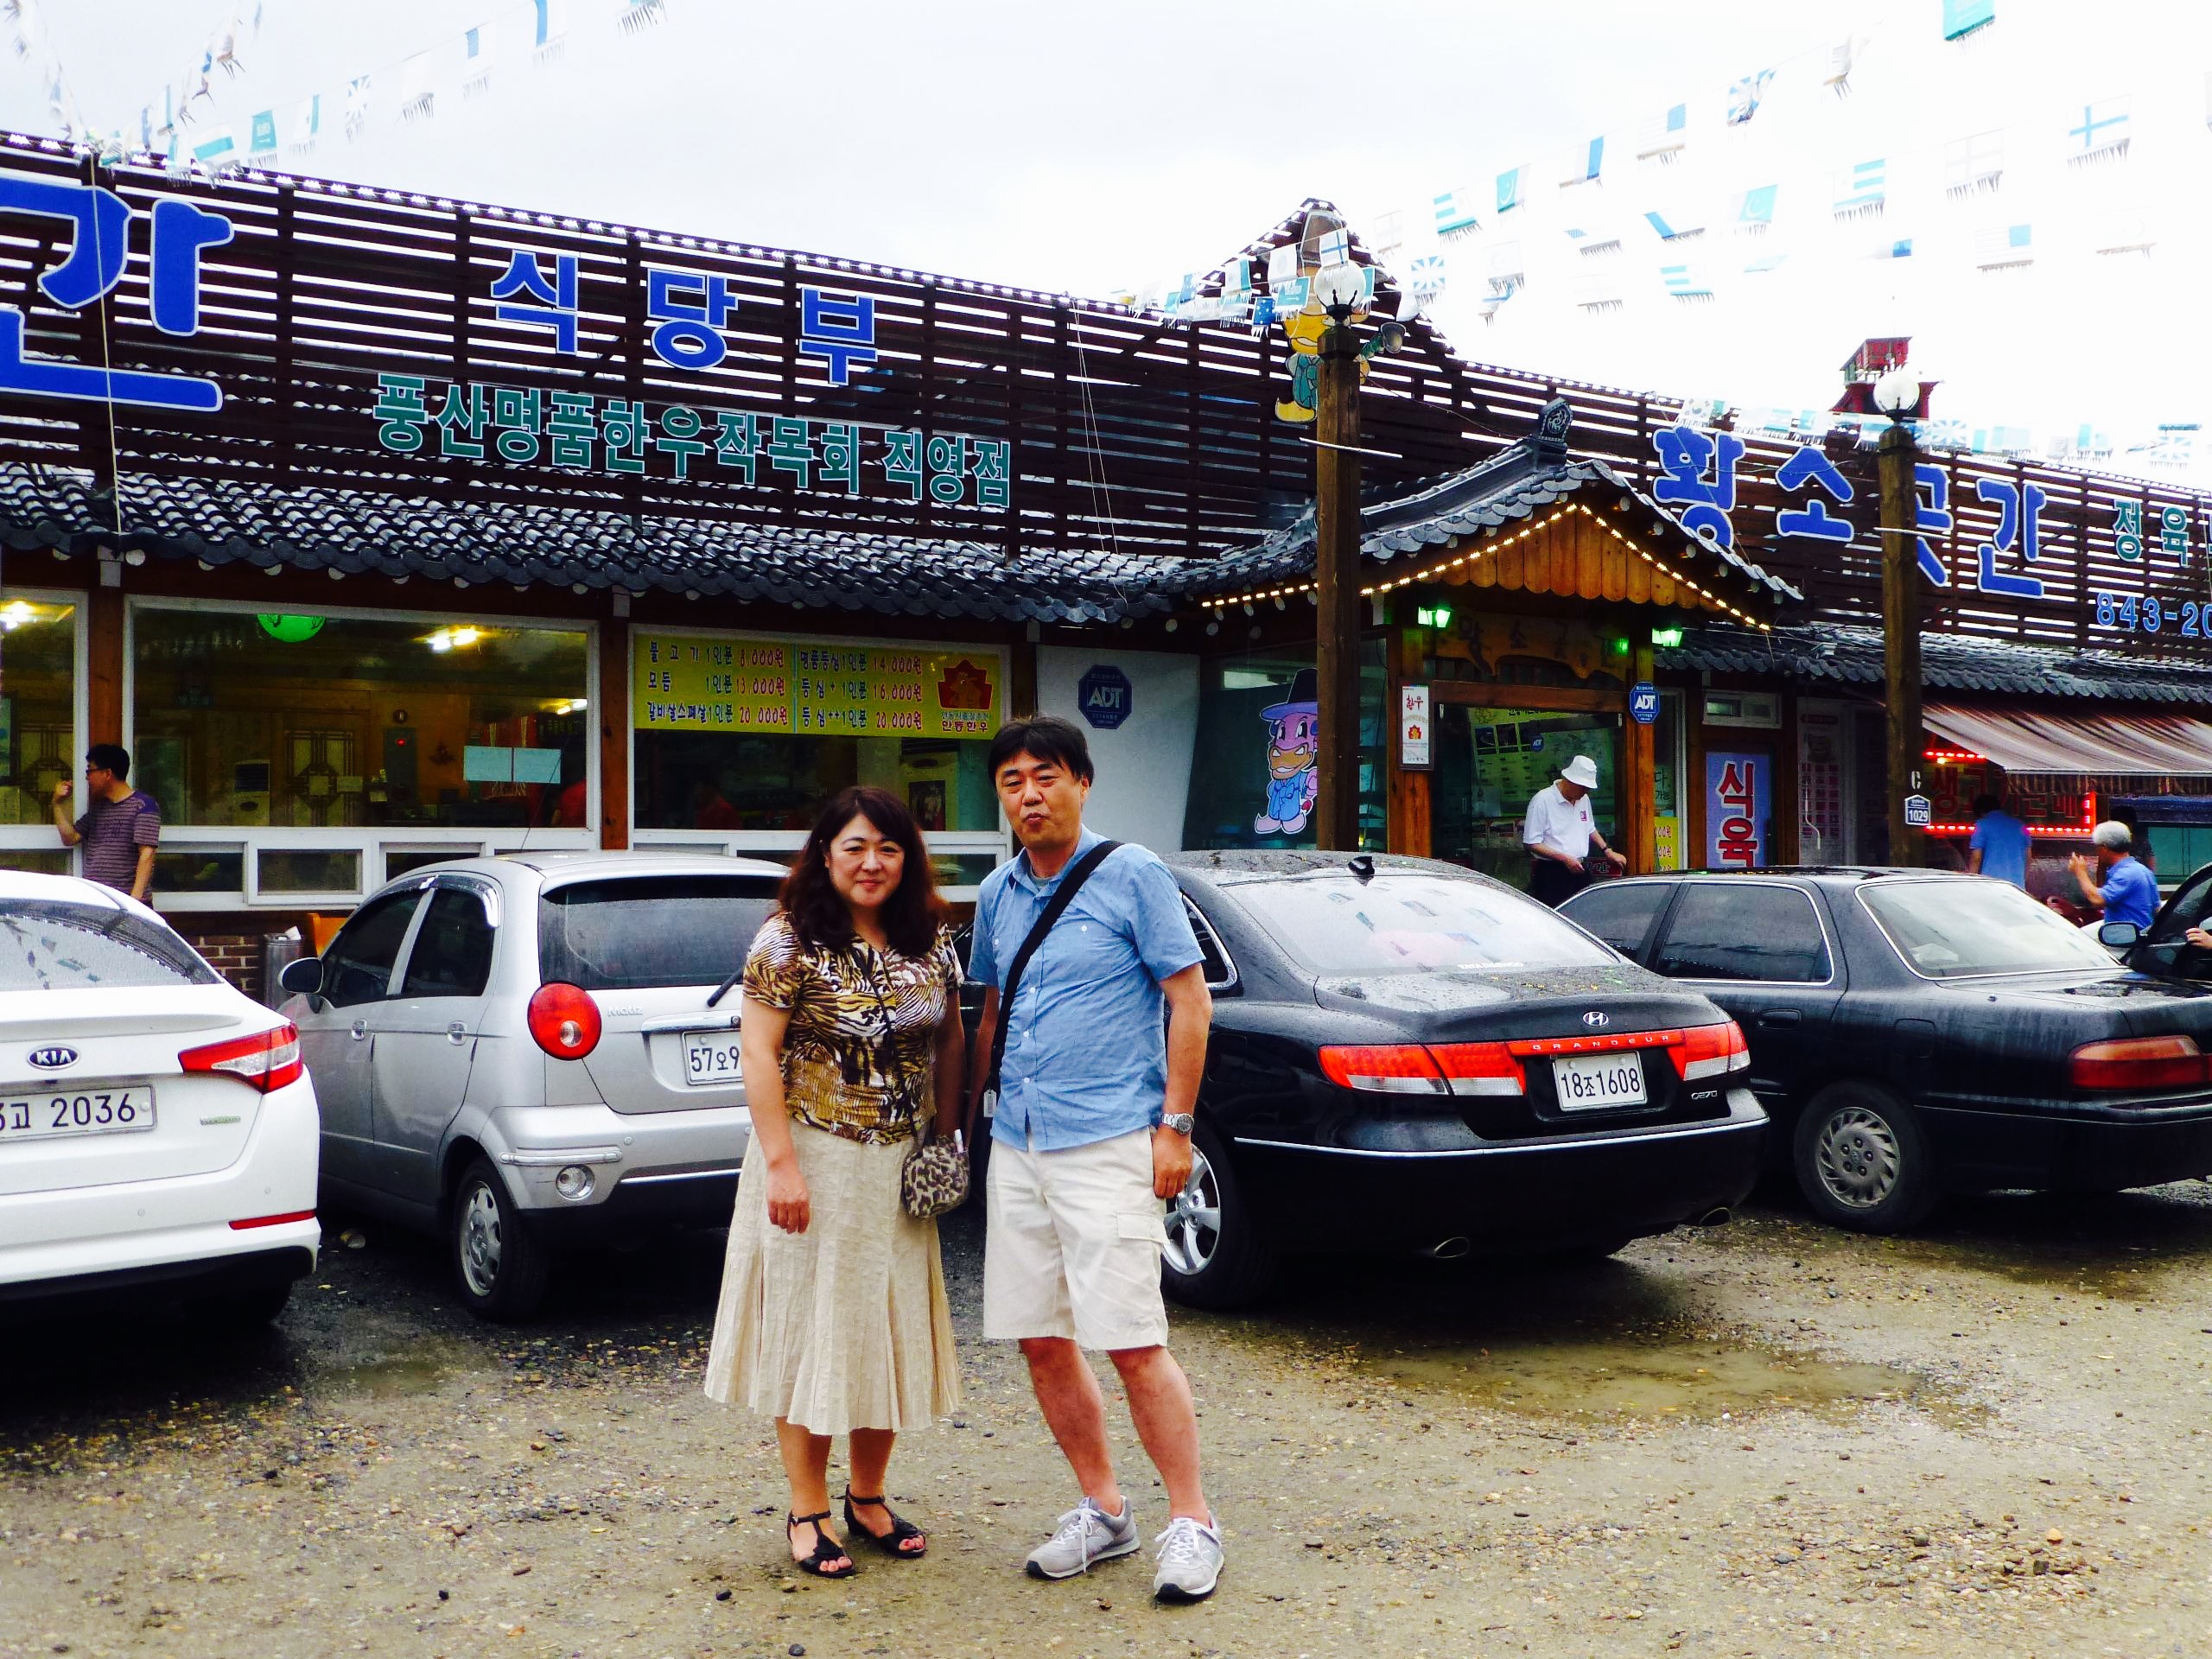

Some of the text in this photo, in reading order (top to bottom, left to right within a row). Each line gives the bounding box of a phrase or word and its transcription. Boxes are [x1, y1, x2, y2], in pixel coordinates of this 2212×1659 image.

[490, 249, 878, 386] 식당부
[372, 372, 1011, 509] 풍산명품한우작목회 직영점
[873, 654, 922, 675] 14,000원
[735, 676, 785, 696] 13,000원
[873, 683, 922, 702] 16,000원
[1087, 686, 1124, 709] ADT
[1635, 694, 1656, 710] ADT
[740, 705, 789, 726] 20,000원
[875, 710, 922, 731] 20,000원
[941, 721, 989, 733] 안동한우
[1909, 810, 1929, 822] 1029
[607, 1004, 644, 1018] Matiz
[1532, 1034, 1669, 1051] GRANDEUR
[35, 1050, 73, 1065] KIA
[1560, 1067, 1642, 1100] 18조1608
[50, 1092, 136, 1129] 2036
